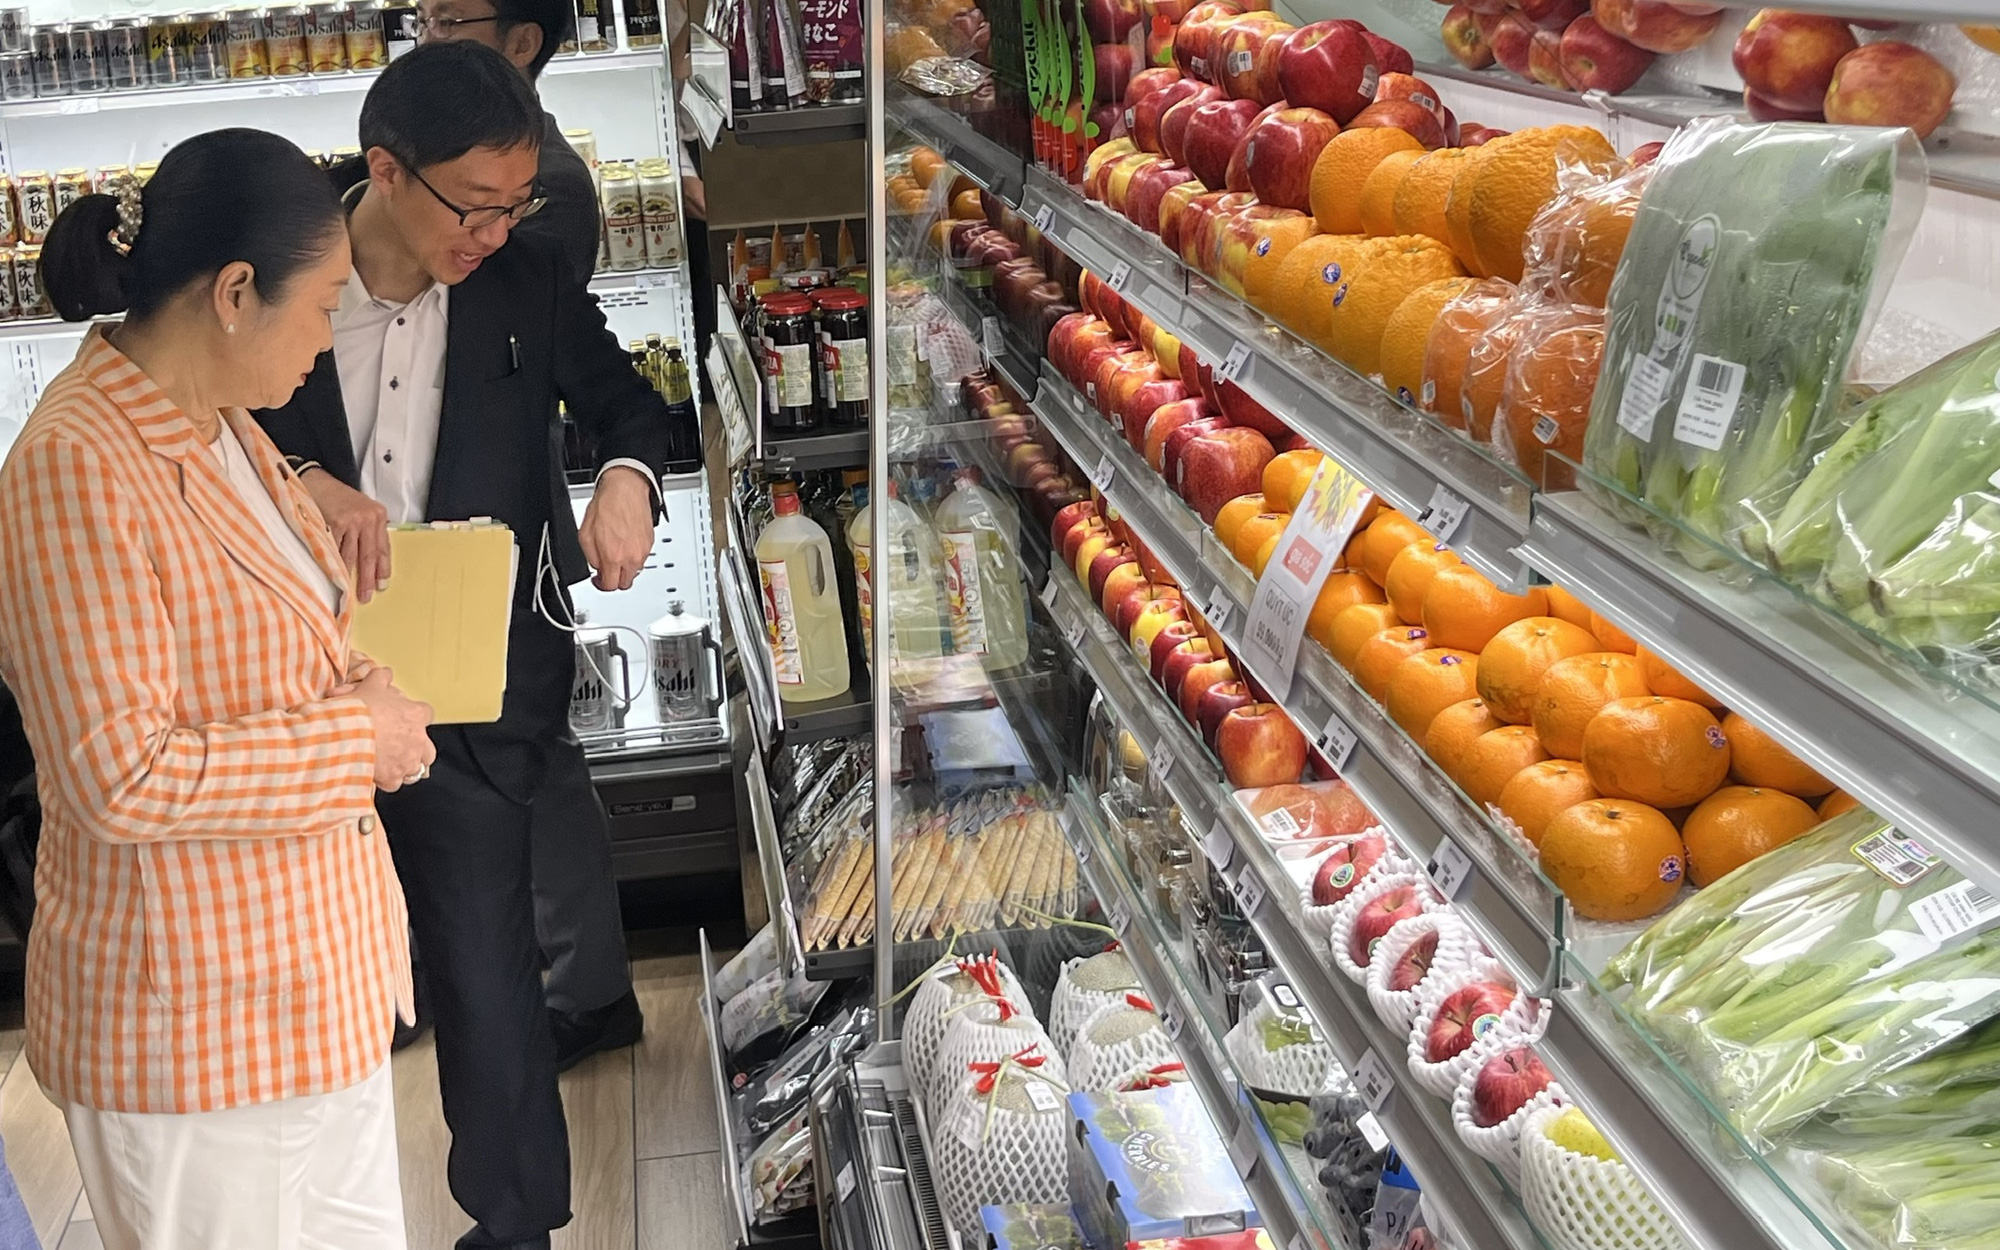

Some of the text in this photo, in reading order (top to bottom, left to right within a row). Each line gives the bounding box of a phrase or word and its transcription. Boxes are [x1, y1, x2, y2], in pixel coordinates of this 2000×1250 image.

[799, 0, 849, 19] アーモンド
[804, 23, 839, 43] きなこ
[655, 658, 679, 669] DRY
[1128, 1132, 1170, 1172] CHERRIES
